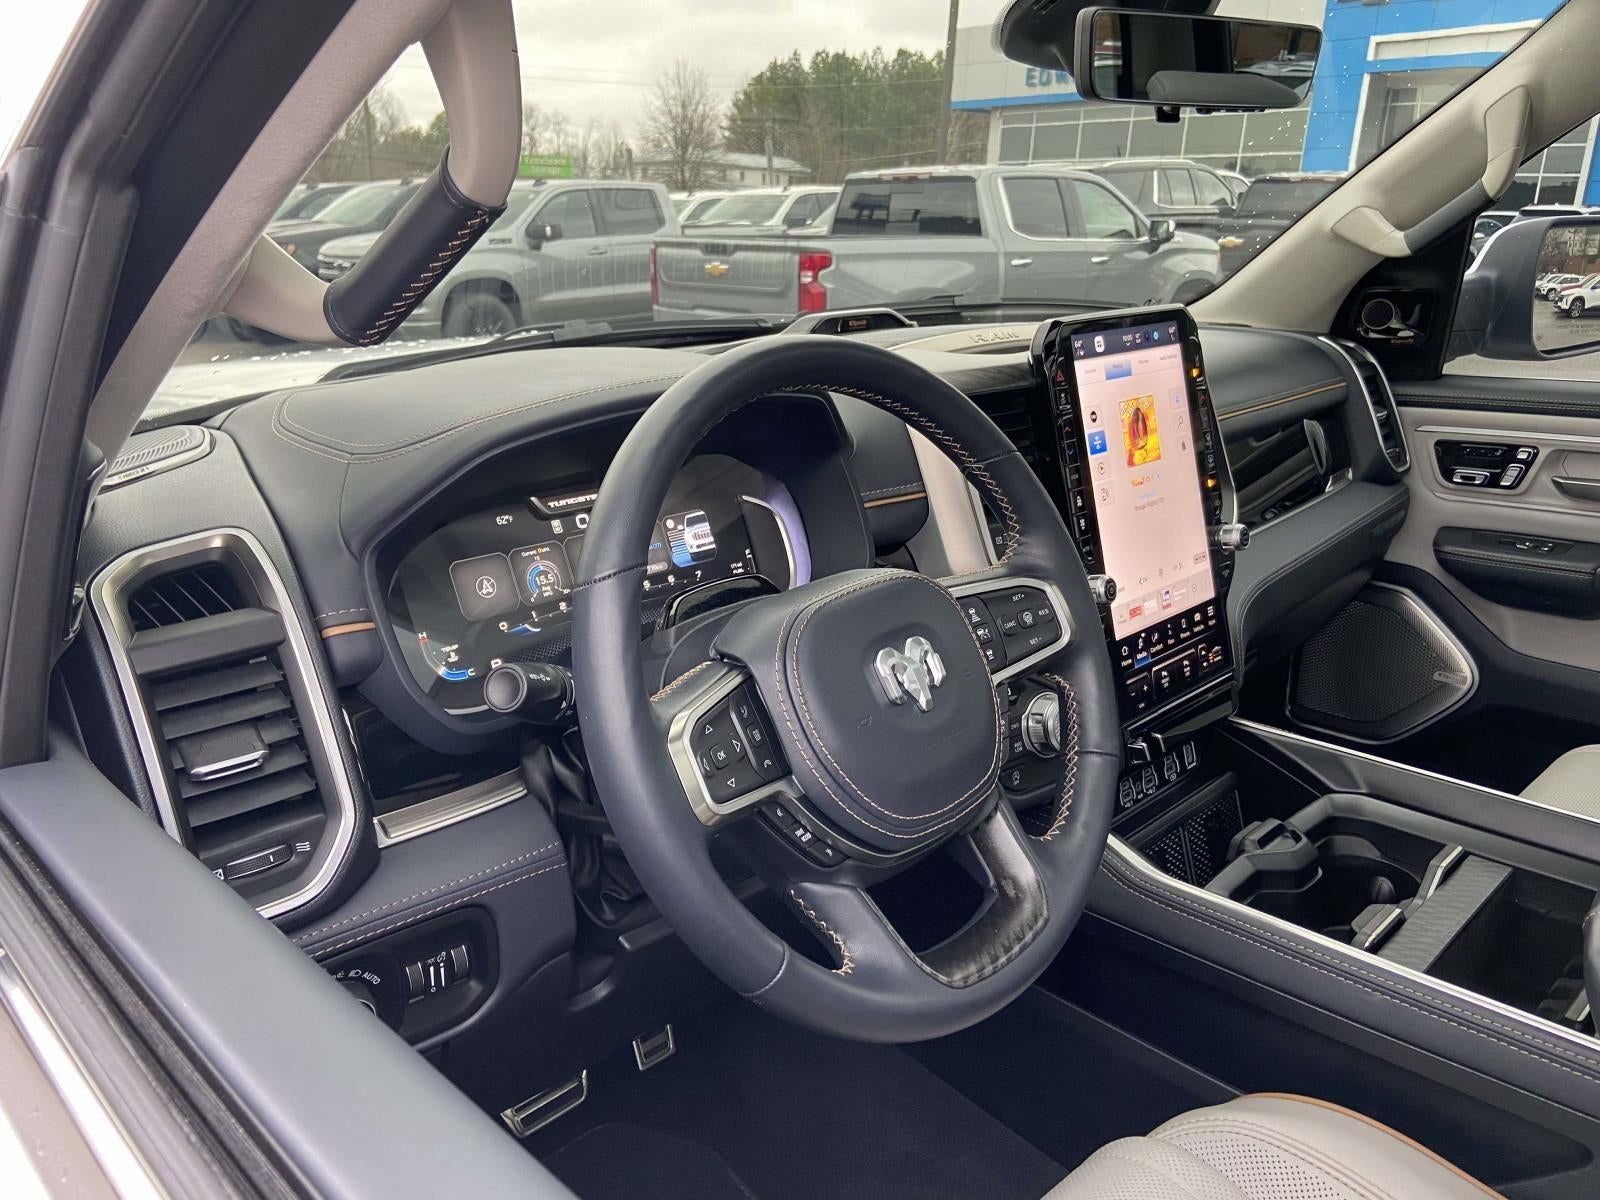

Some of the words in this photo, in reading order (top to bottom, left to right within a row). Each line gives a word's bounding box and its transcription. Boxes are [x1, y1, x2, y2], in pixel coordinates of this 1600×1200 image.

[535, 573, 554, 586] 15.5
[717, 750, 727, 761] OK
[362, 971, 381, 985] AUTO
